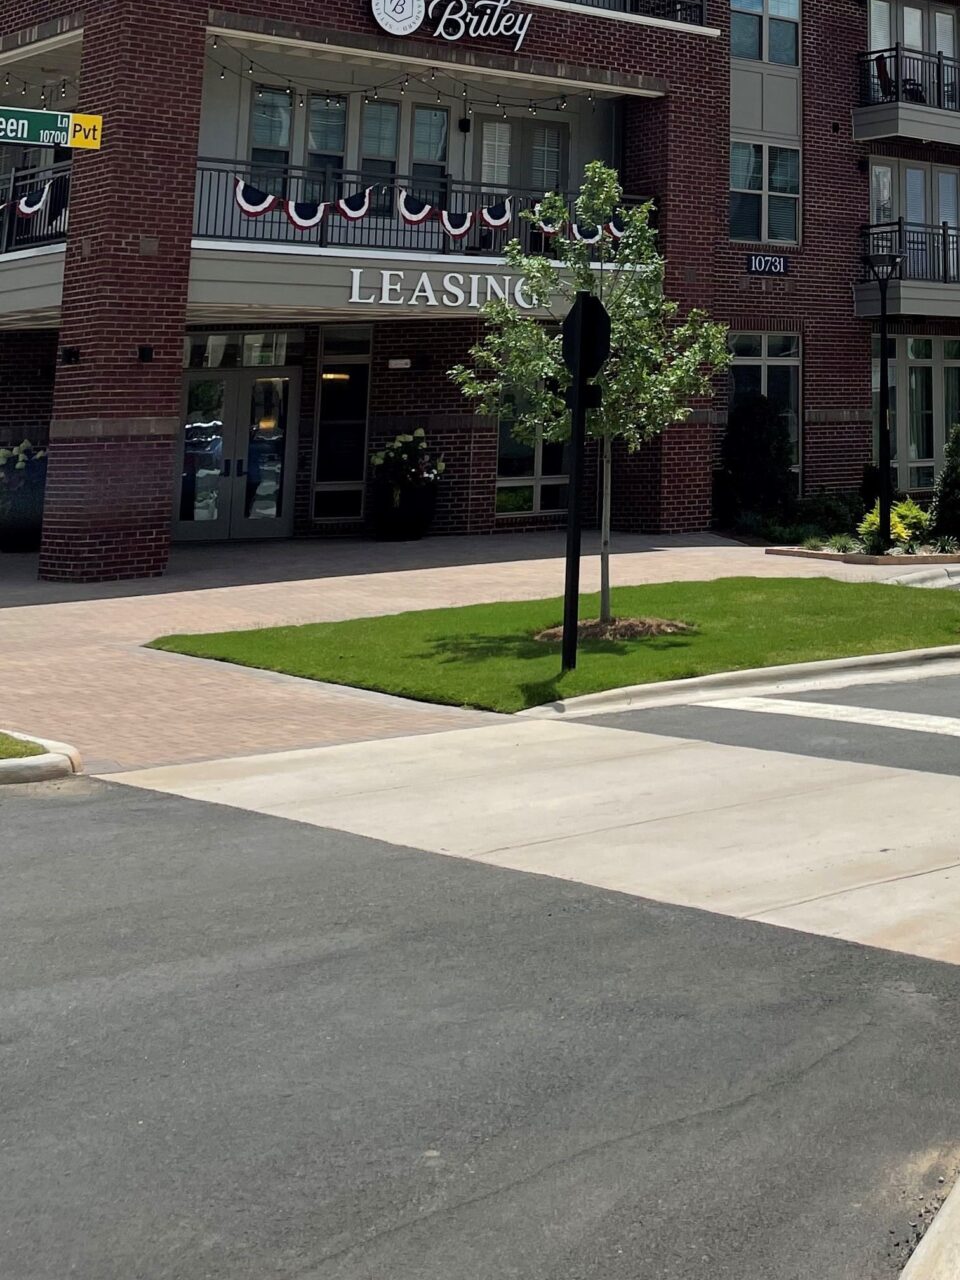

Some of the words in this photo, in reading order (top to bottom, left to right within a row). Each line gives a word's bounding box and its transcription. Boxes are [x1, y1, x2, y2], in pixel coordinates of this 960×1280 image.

[57, 114, 68, 127] Ln
[39, 129, 68, 144] 10700
[72, 123, 98, 140] Pvt
[751, 255, 785, 273] 10731
[348, 268, 540, 309] LEASING
